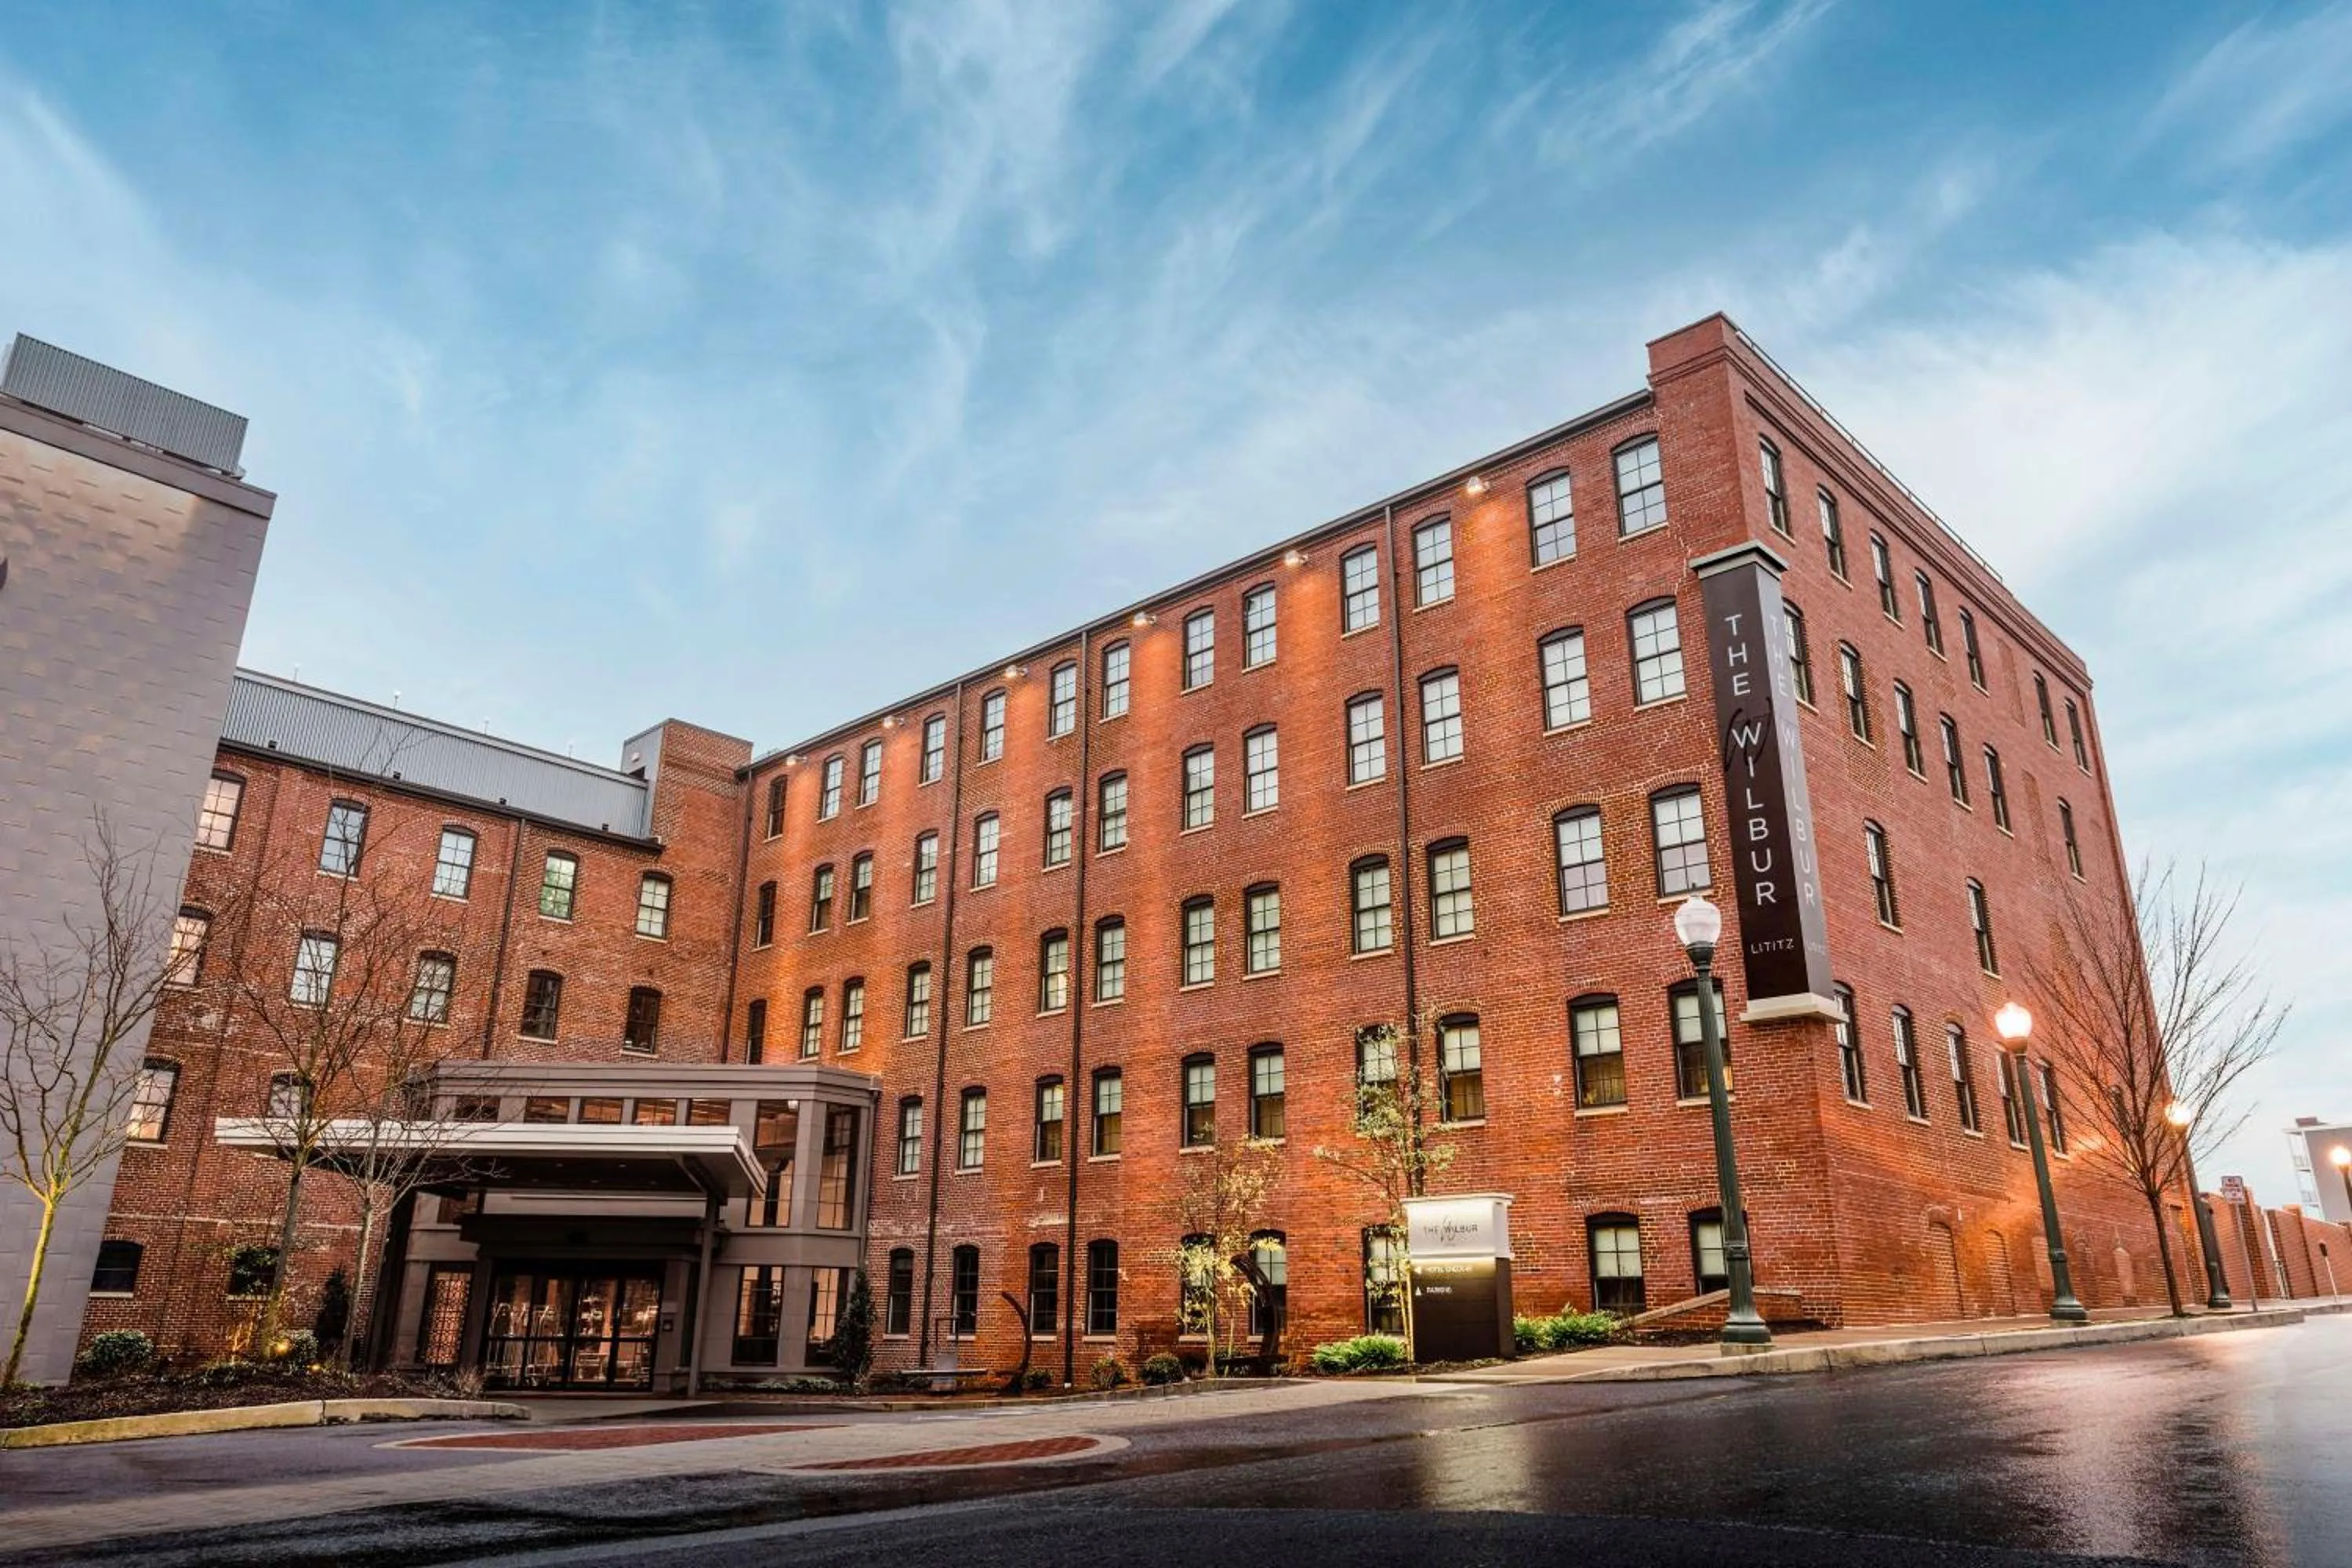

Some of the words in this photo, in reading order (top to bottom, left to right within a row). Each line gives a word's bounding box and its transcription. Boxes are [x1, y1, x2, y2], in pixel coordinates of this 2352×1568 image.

[1725, 614, 1751, 696] THE
[1731, 721, 1777, 906] WILBUR
[1769, 615, 1789, 698] THE
[1780, 723, 1815, 907] WILBUR
[1751, 938, 1795, 954] LITITZ
